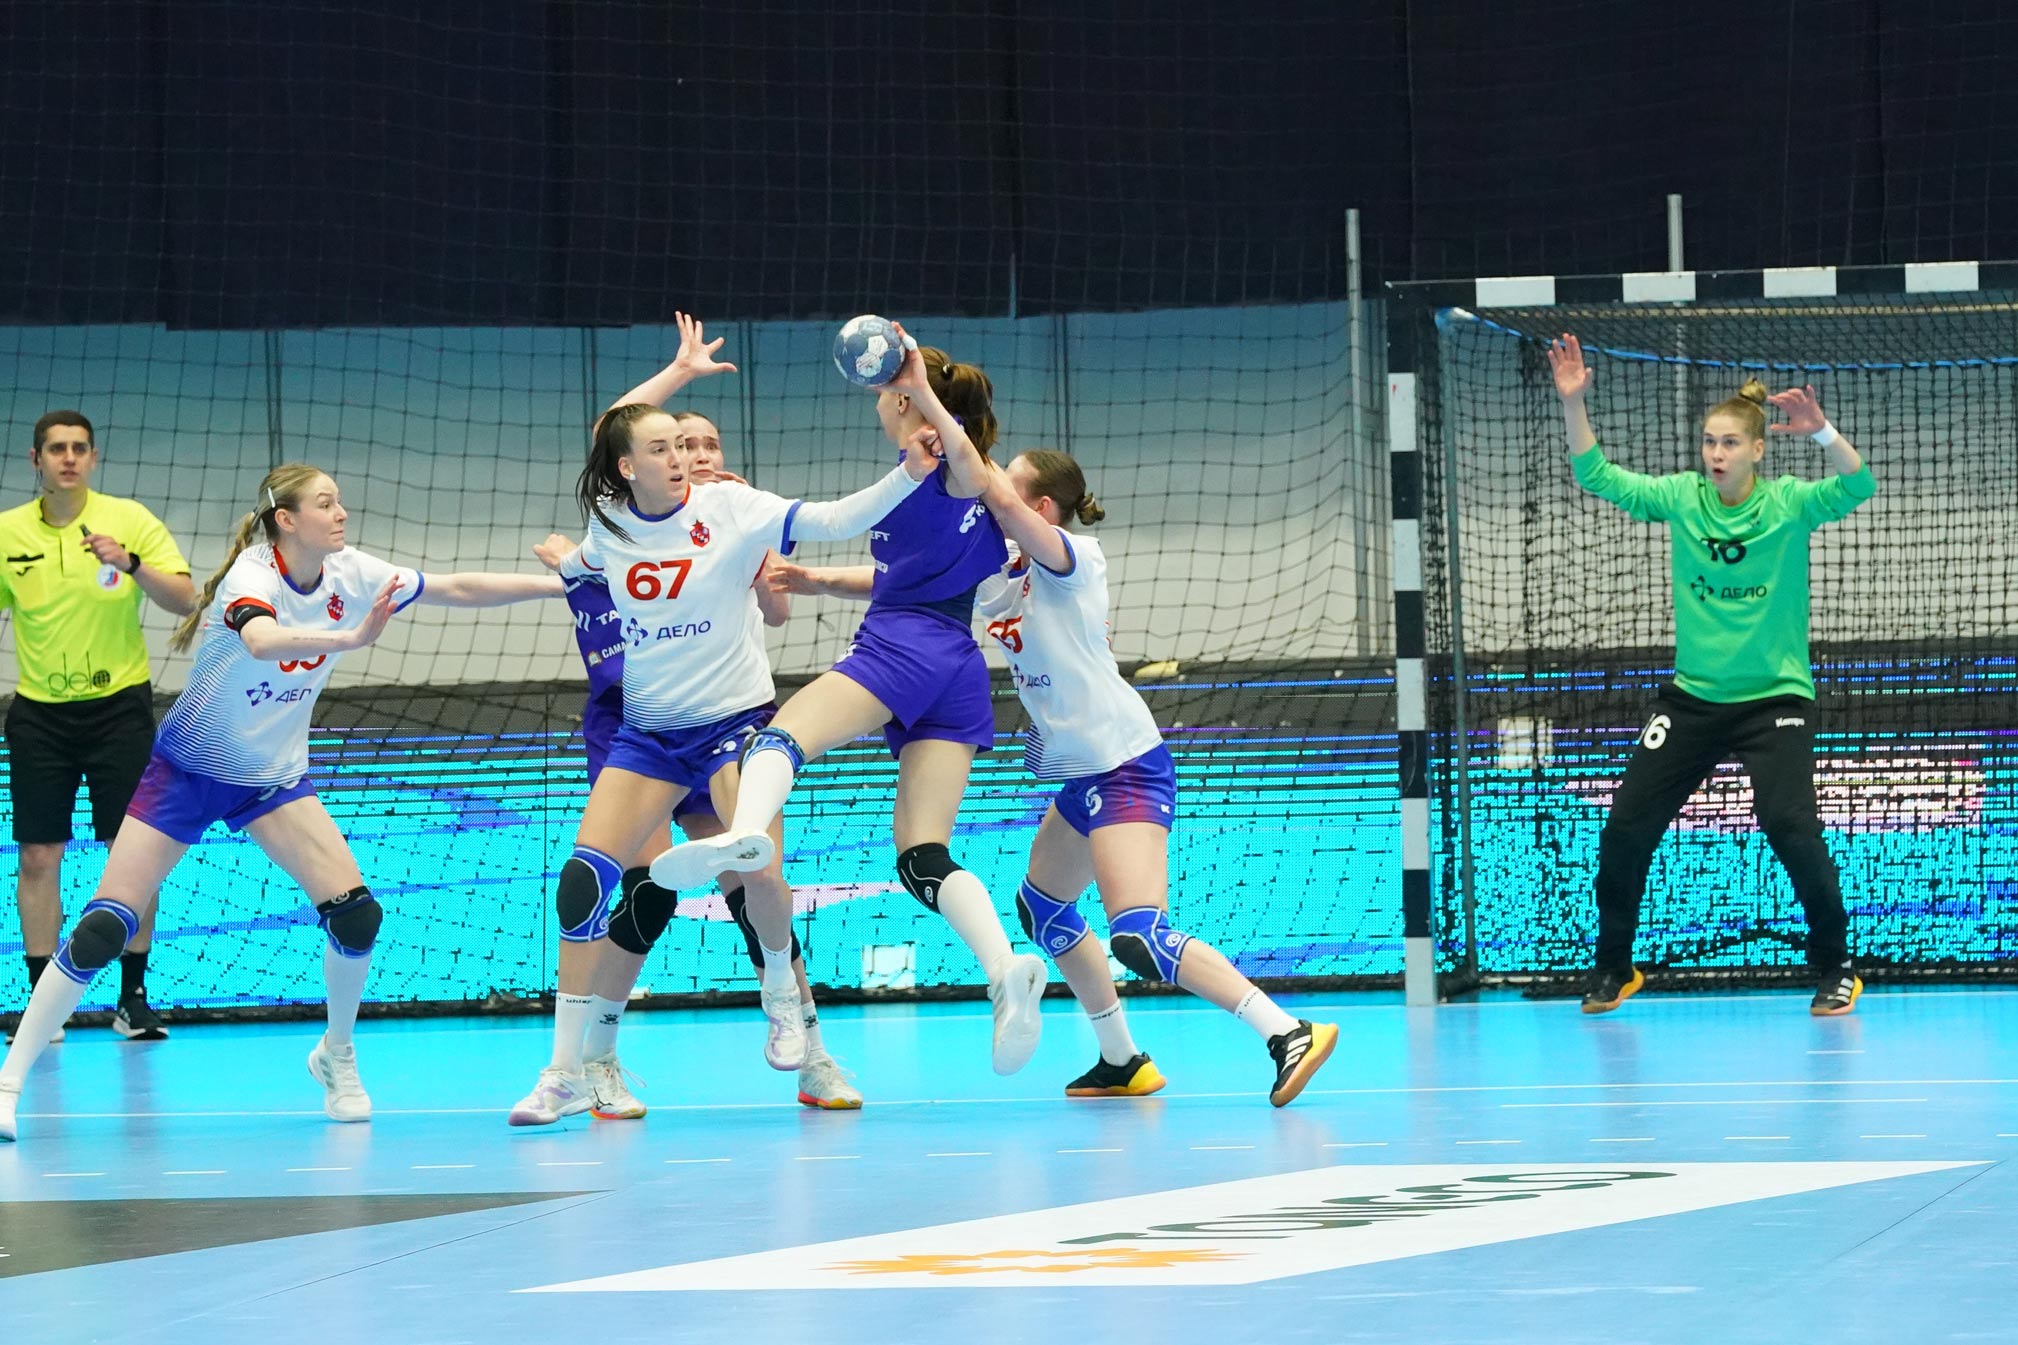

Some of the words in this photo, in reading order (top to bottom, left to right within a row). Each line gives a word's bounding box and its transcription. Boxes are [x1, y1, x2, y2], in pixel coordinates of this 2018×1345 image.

[626, 559, 693, 601] 67
[1721, 585, 1767, 599] ДЕЛО
[656, 620, 711, 640] ДЕЛО
[601, 641, 627, 659] САМА
[275, 688, 312, 703] ДЕЛ
[1638, 712, 1672, 750] 6
